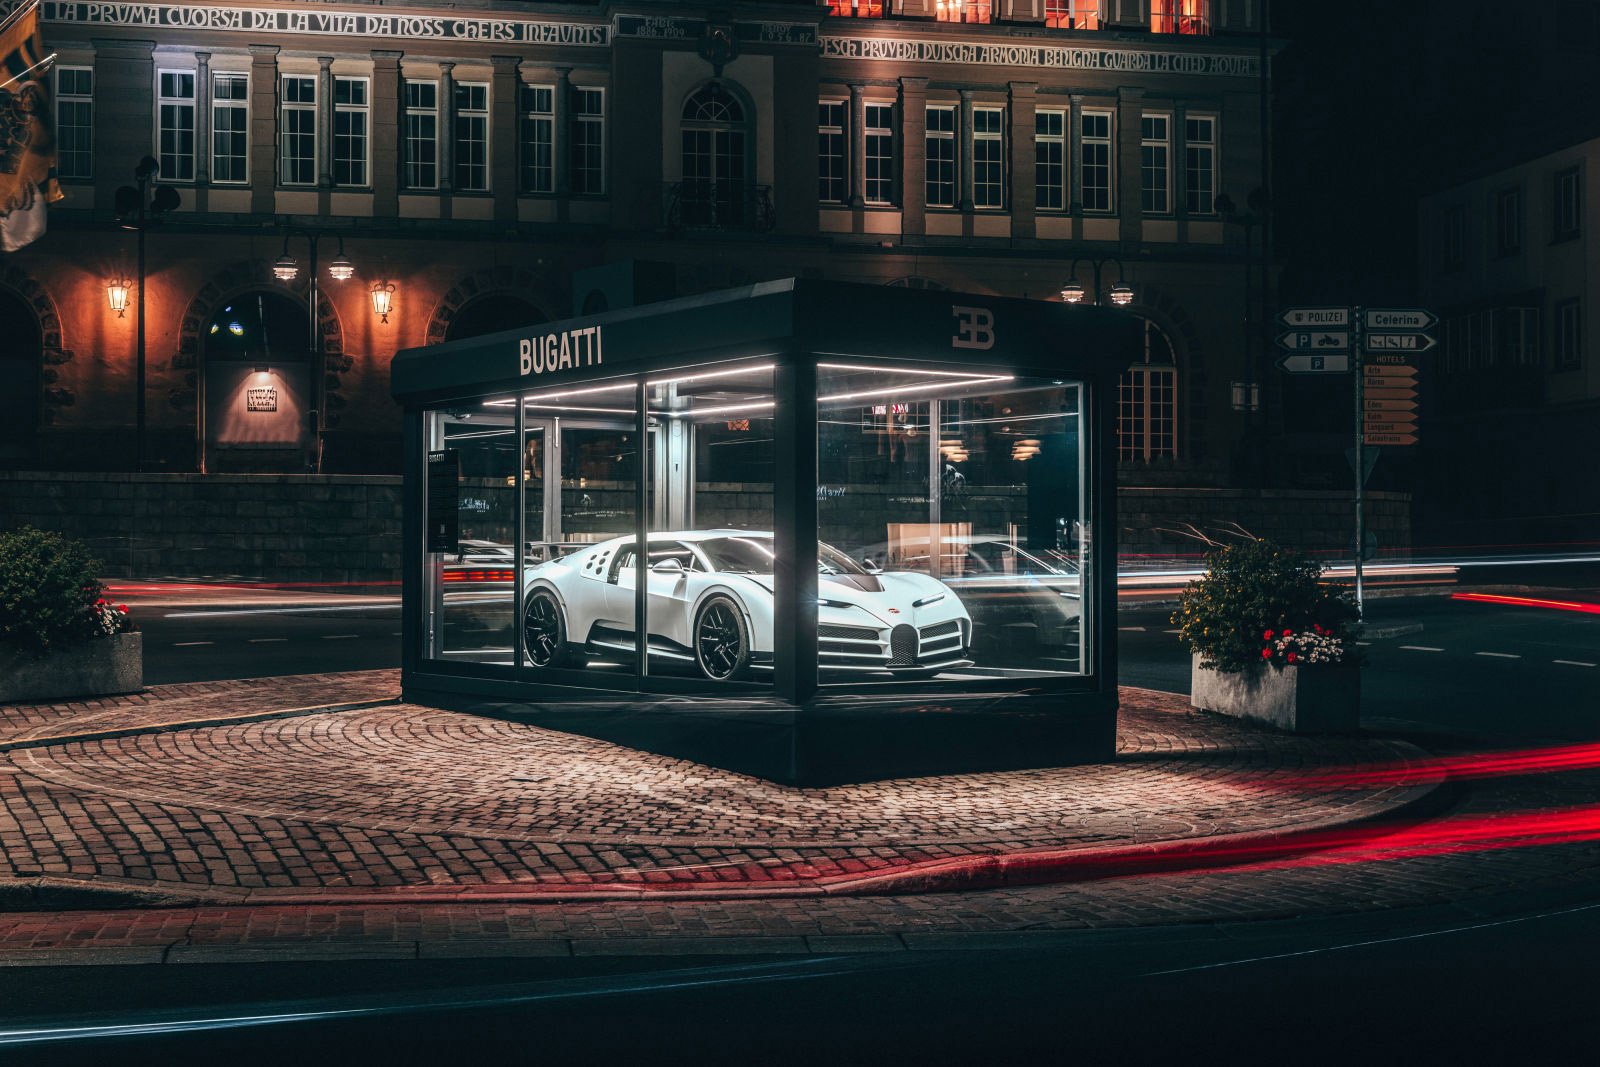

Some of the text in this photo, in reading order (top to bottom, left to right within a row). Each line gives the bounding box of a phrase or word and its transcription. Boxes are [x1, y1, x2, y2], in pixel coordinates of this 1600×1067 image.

[55, 3, 77, 20] LA
[166, 8, 242, 28] CUORSA
[252, 11, 277, 29] DA
[287, 12, 309, 31] LA
[316, 14, 357, 33] VITA
[366, 16, 391, 34] DA
[398, 17, 444, 37] NOSS
[1104, 52, 1151, 70] GUARDA
[1155, 54, 1169, 71] LA
[1308, 312, 1343, 322] POLIZEI
[1375, 314, 1420, 325] Celerina
[1300, 335, 1309, 347] P
[519, 325, 603, 376] BUGATTI
[1376, 355, 1407, 363] HOTELS
